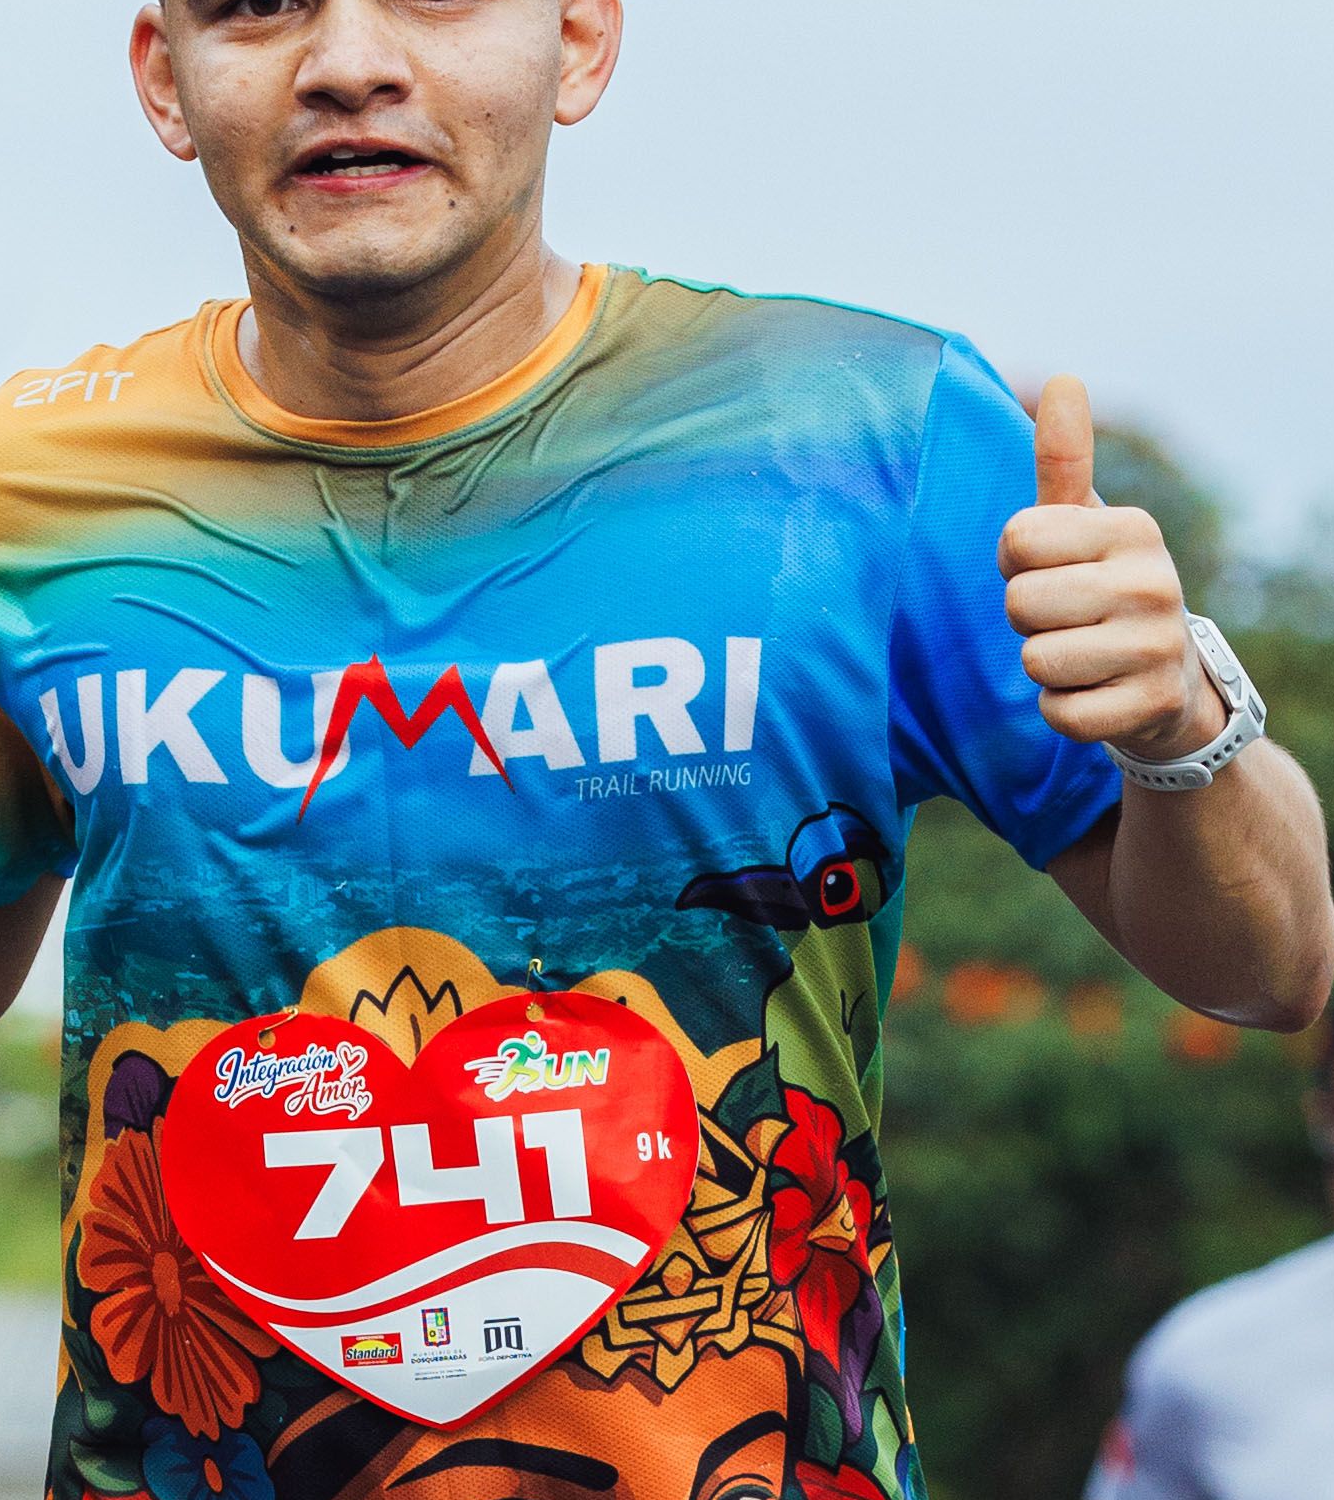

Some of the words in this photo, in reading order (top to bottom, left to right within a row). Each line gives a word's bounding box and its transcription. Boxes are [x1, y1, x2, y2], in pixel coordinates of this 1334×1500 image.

[12, 369, 135, 409] 2FIT
[38, 635, 763, 826] UKUMARI
[575, 772, 642, 802] TRAIL
[648, 761, 752, 793] RUNNING
[216, 1045, 336, 1100] Integración
[286, 1070, 364, 1118] Amor
[262, 1108, 593, 1242] 741
[346, 1344, 398, 1361] Standard
